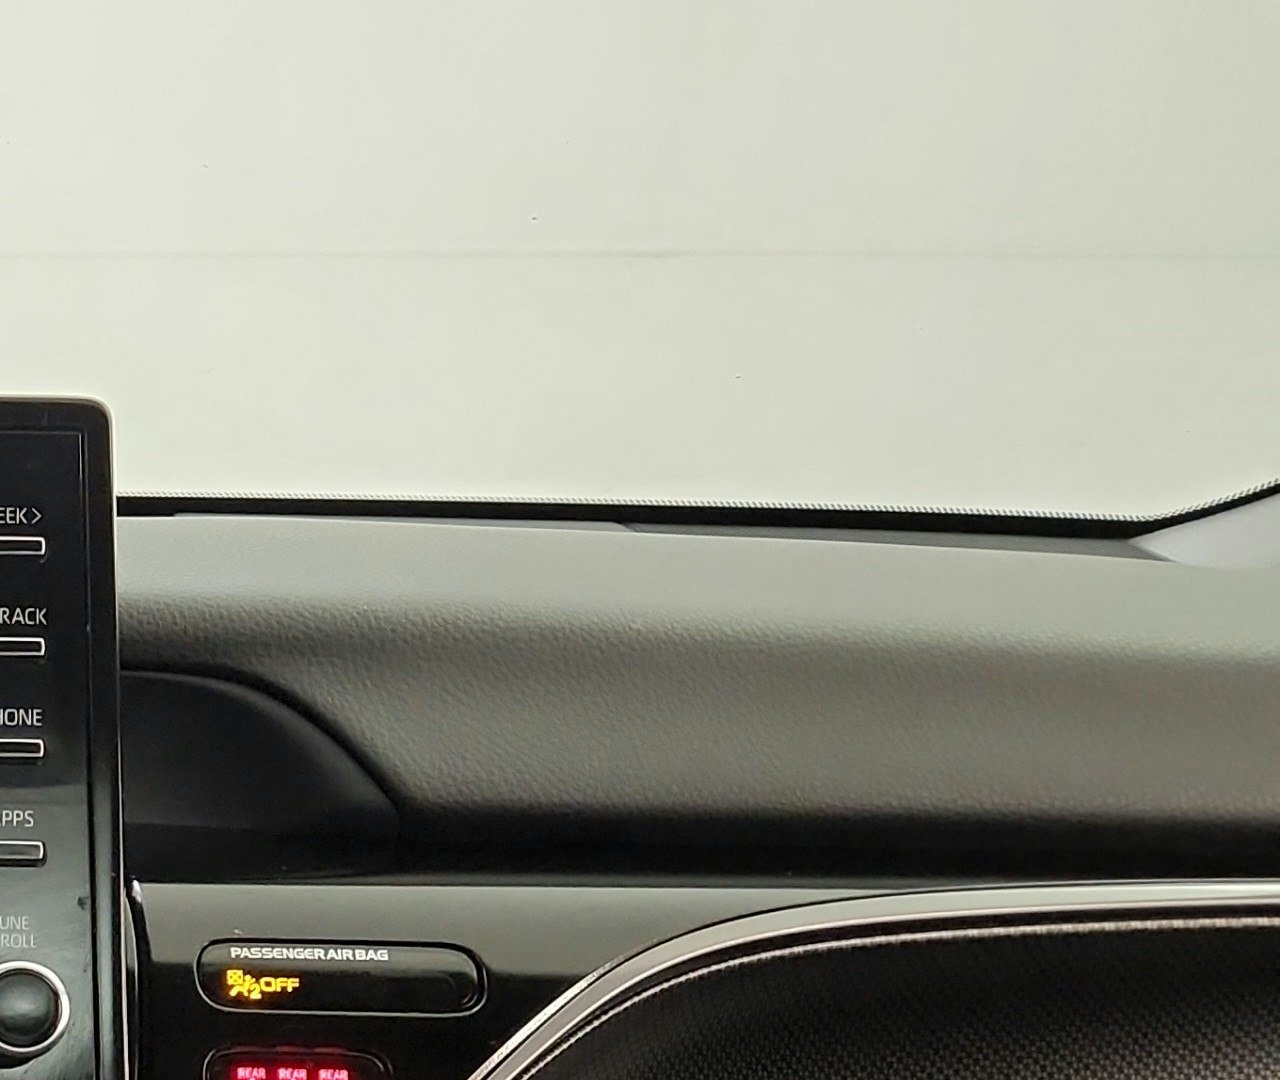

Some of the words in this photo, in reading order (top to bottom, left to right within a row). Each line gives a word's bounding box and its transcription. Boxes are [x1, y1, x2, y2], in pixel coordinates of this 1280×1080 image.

[229, 946, 326, 960] PASSENGER
[354, 949, 389, 961] BAG
[259, 976, 300, 993] OFF
[237, 1067, 266, 1080] REAR
